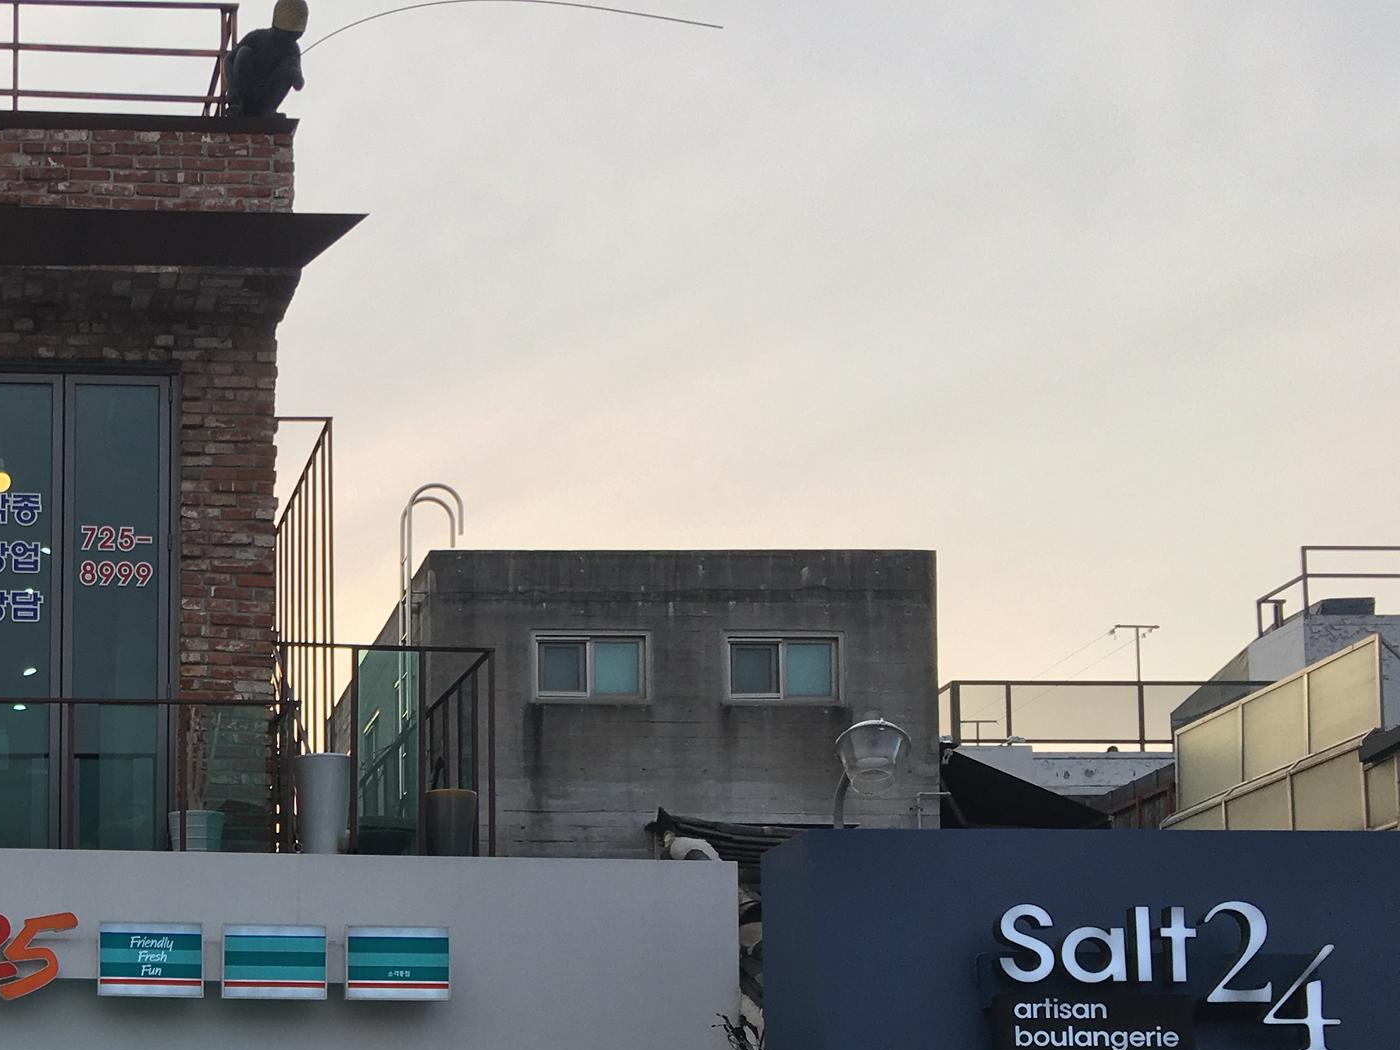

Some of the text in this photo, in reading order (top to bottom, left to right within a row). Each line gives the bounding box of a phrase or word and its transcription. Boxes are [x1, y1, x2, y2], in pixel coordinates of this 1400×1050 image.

[81, 525, 153, 551] 725-
[79, 560, 153, 587] 8999
[130, 935, 174, 951] Friendly
[137, 950, 167, 963] Fresh
[141, 964, 162, 976] Fun
[1013, 998, 1107, 1020] artisan
